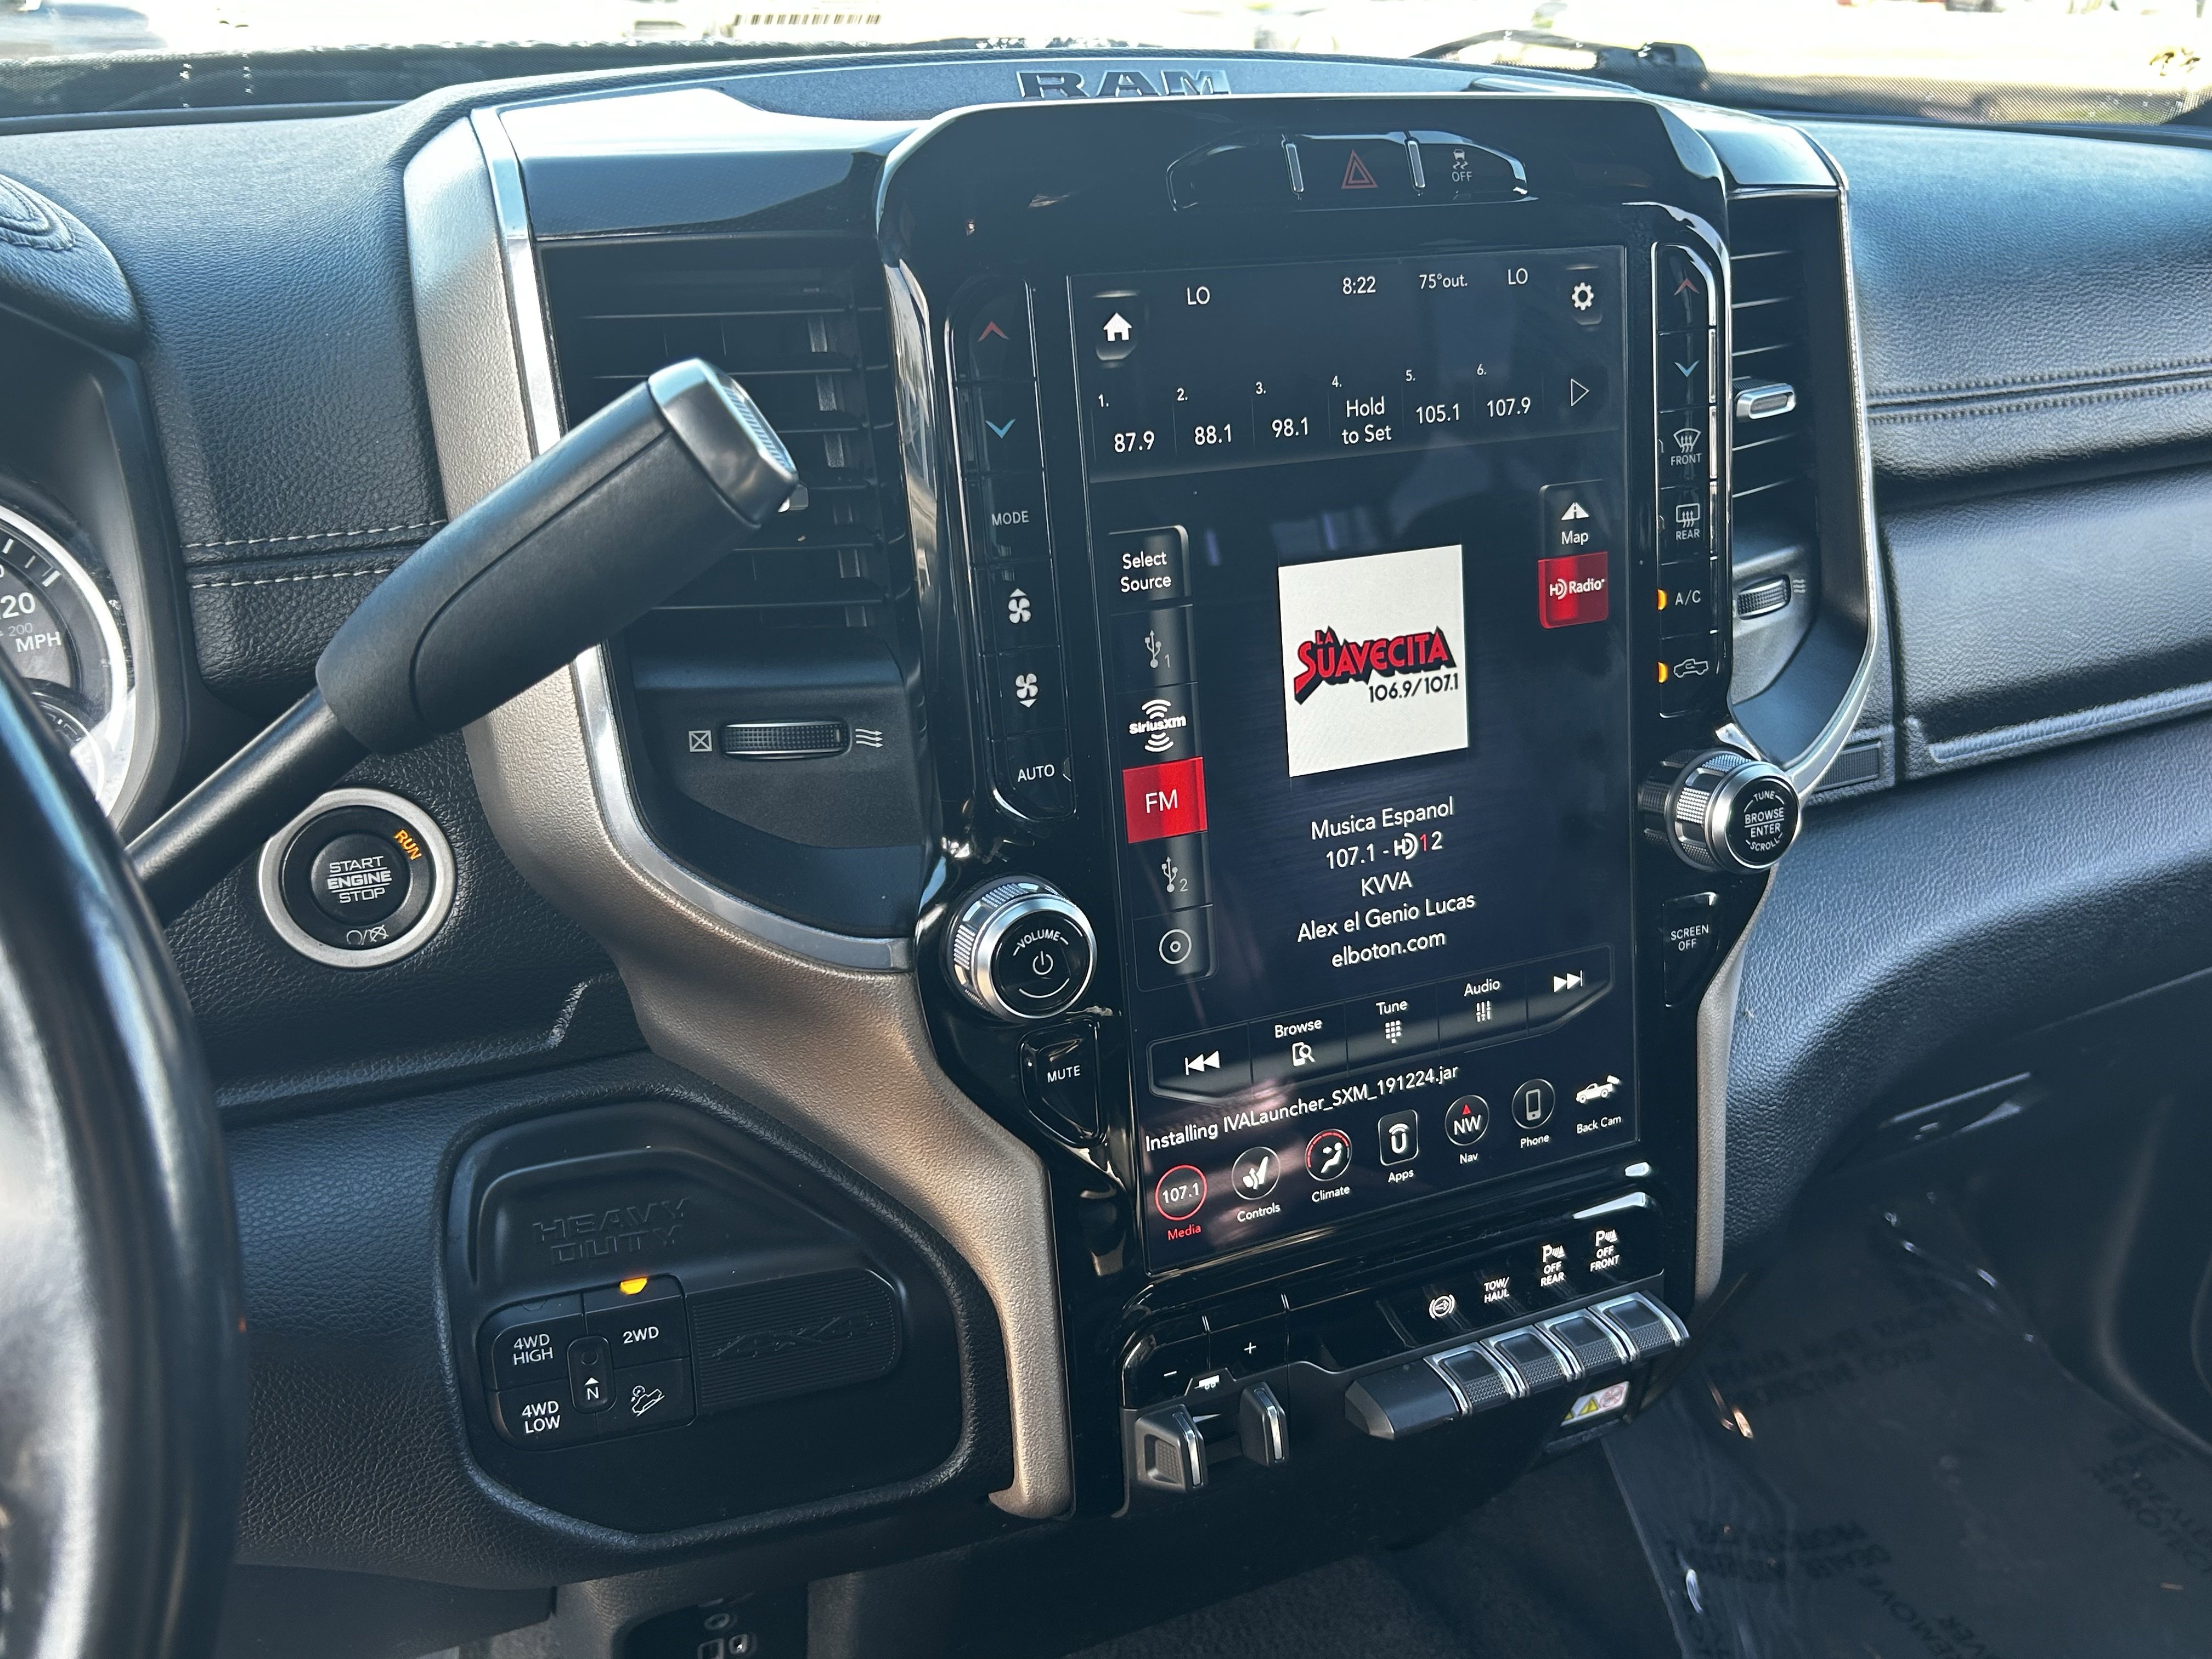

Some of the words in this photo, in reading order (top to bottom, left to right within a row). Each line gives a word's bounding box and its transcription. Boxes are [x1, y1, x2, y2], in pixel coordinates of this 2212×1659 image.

[1017, 70, 1232, 98] RAM
[1452, 171, 1473, 183] OFF
[1342, 276, 1376, 295] 8:22
[1419, 273, 1468, 290] 75°out.
[1507, 268, 1528, 285] LO
[1187, 286, 1210, 306] LO
[1406, 370, 1416, 382] 5.
[1476, 364, 1487, 376] 6.
[1256, 381, 1266, 394] 3.
[1331, 376, 1342, 388] 4.
[1098, 394, 1109, 408] 1.
[1177, 388, 1188, 402] 2.
[1346, 396, 1385, 418] Hold
[1416, 403, 1460, 424] 105.1
[1487, 397, 1531, 418] 107.9
[1194, 424, 1232, 446] 88.1
[1272, 417, 1308, 438] 98.1
[1342, 428, 1359, 445] to
[1364, 424, 1392, 443] Set
[1114, 431, 1155, 453] 87.9
[1671, 453, 1702, 466] FRONT
[991, 511, 1029, 526] MODE
[1561, 531, 1589, 545] Map
[1675, 528, 1700, 541] REAR
[1122, 550, 1167, 570] Select
[1120, 574, 1171, 593] Source
[0, 592, 36, 619] 20
[1674, 590, 1701, 606] A/C
[8, 623, 33, 637] 200
[15, 631, 61, 652] MPH
[1293, 625, 1457, 706] SUAVECITA
[1369, 672, 1459, 703] 106.9/107.1
[1018, 764, 1055, 782] AUTO
[1146, 789, 1178, 814] FM
[1753, 790, 1775, 802] TUNE
[1311, 815, 1376, 840] Musica
[1381, 795, 1454, 828] Espanol
[1745, 807, 1785, 825] BROWSE
[1750, 823, 1781, 838] ENTER
[393, 829, 422, 861] RUN
[1750, 838, 1780, 852] SCROLL
[329, 856, 384, 873] START
[1325, 843, 1374, 870] 107.1
[327, 870, 392, 890] ENGINE
[1361, 870, 1413, 897] KVVA
[339, 887, 385, 904] STOP
[1297, 919, 1339, 943] Alex
[1344, 911, 1360, 932] el
[1365, 903, 1419, 929] Genio
[1425, 894, 1476, 917] Lucas
[1017, 929, 1061, 949] VOLUME
[1671, 924, 1709, 941] SCREEN
[1331, 932, 1446, 968] elboton.com
[1678, 938, 1697, 952] OFF
[1464, 978, 1501, 997] Audio
[1376, 999, 1408, 1017] Tune
[1274, 1018, 1323, 1039] Browse
[1047, 1065, 1081, 1083] MUTE
[1453, 1114, 1482, 1136] NW
[1577, 1119, 1599, 1135] Back
[1600, 1114, 1622, 1129] Cam
[1145, 1122, 1219, 1152] Installing
[1520, 1133, 1550, 1149] Phone
[1459, 1152, 1479, 1165] Nav
[1387, 1167, 1414, 1184] Apps
[1162, 1182, 1200, 1205] 107.1
[1311, 1184, 1351, 1204] Climate
[532, 1197, 690, 1243] HEAVY
[1237, 1202, 1282, 1223] Controls
[1167, 1223, 1201, 1242] Media
[550, 1224, 682, 1265] DUTY
[1596, 1245, 1615, 1260] OFF
[1543, 1261, 1562, 1275] OFF
[1590, 1254, 1620, 1273] FRONT
[1483, 1276, 1510, 1293] TOW/
[1540, 1271, 1565, 1287] REAR
[1483, 1288, 1510, 1305] HAUL
[514, 1334, 550, 1350] 4WD
[623, 1326, 659, 1345] 2WD
[513, 1347, 554, 1365] HIGH
[587, 1386, 600, 1400] N
[522, 1401, 559, 1418] 4WD
[524, 1415, 561, 1434] LOW
